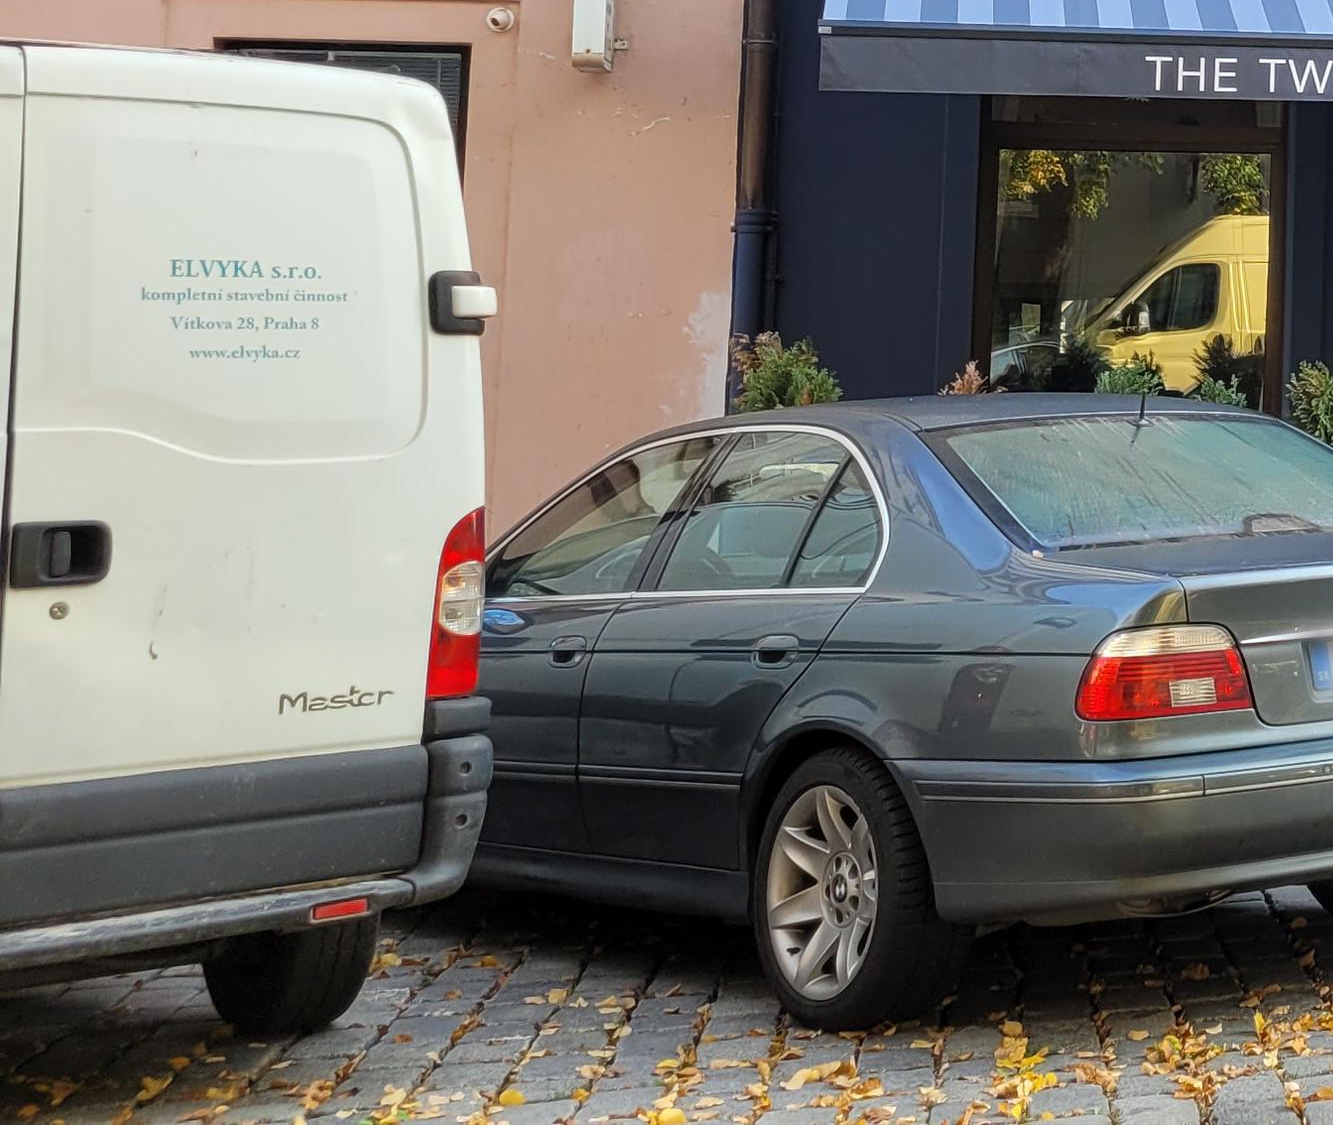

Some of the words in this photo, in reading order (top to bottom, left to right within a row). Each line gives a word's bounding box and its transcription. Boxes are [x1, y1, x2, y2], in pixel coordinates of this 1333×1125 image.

[1144, 56, 1238, 92] THE
[169, 258, 265, 279] ELVYKA
[270, 264, 323, 280] s.r.o.
[140, 286, 224, 306] kompletní
[226, 287, 290, 303] stavební
[293, 288, 349, 303] činnost
[169, 315, 233, 331] Vítkova
[236, 316, 260, 333] 28,
[263, 316, 308, 331] Praha
[310, 316, 320, 331] 8
[188, 344, 303, 364] www.elvyka.cz
[278, 685, 395, 716] Master
